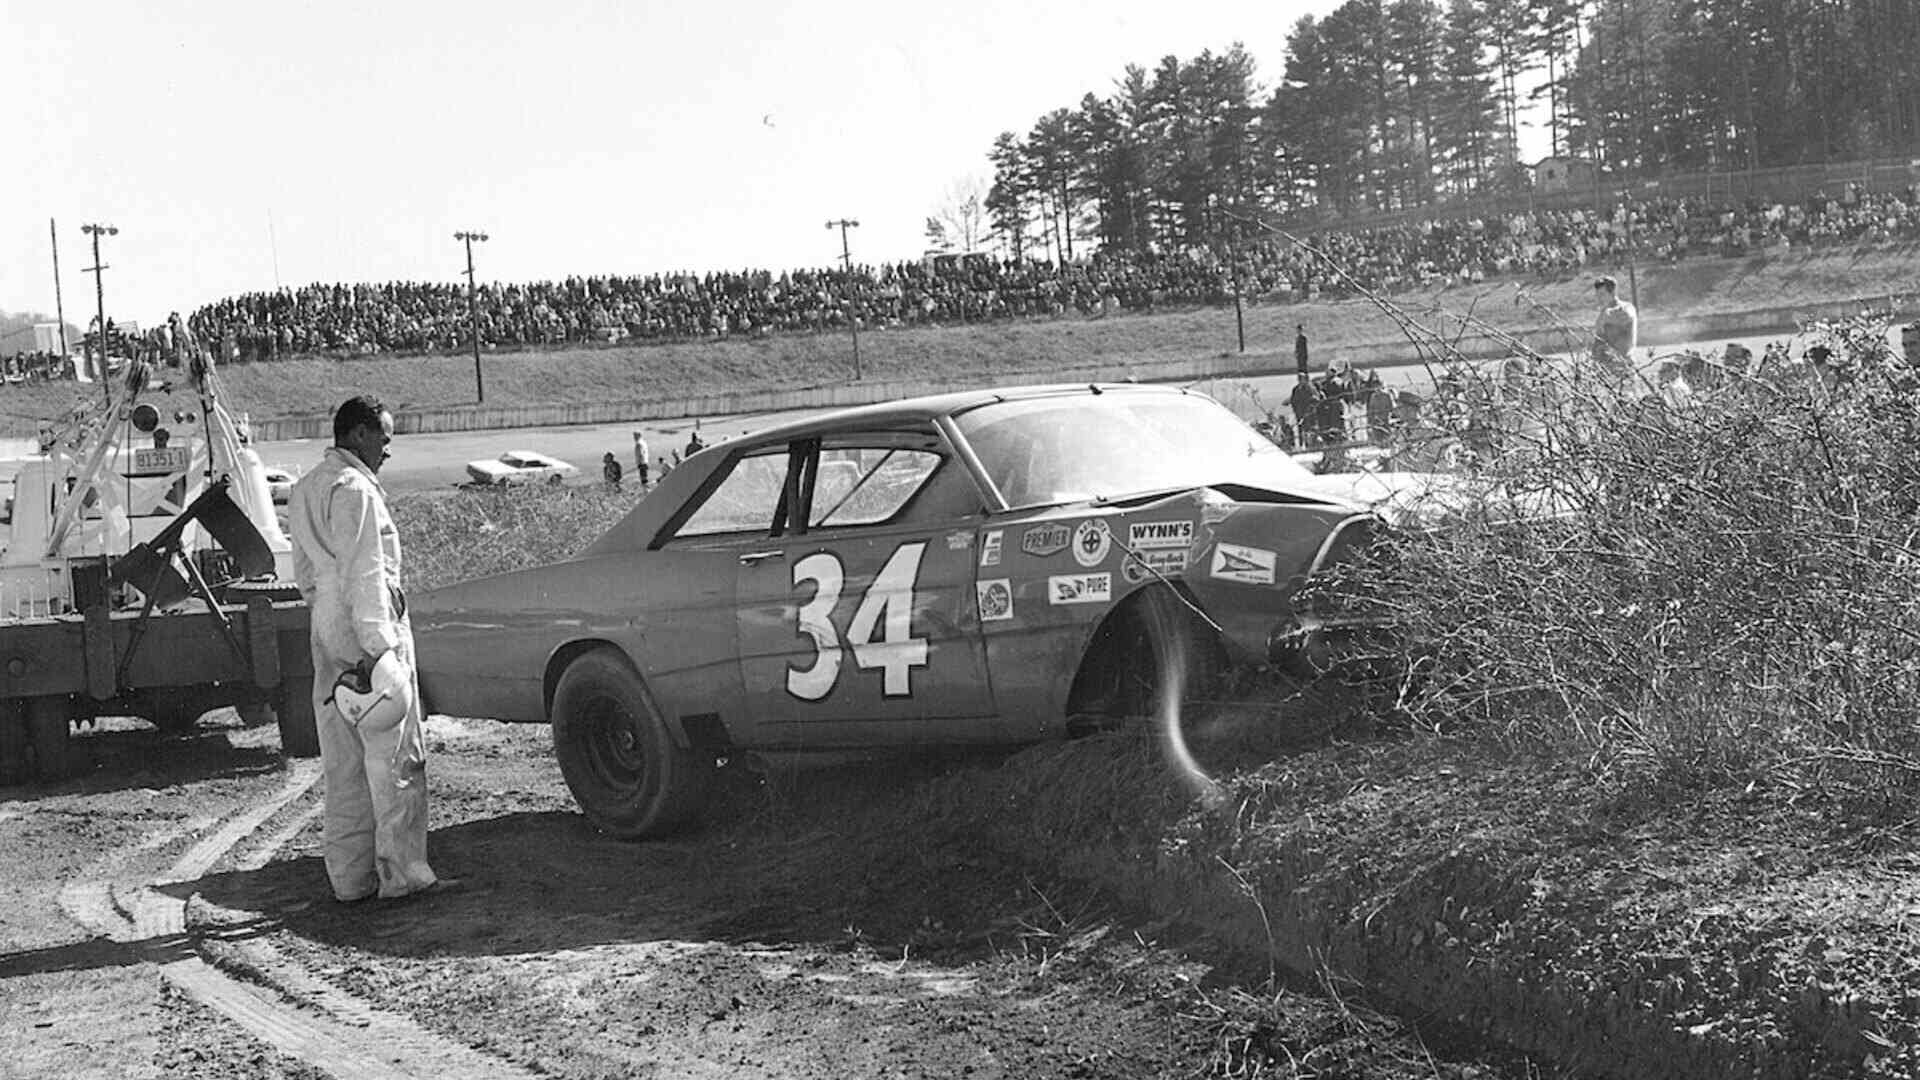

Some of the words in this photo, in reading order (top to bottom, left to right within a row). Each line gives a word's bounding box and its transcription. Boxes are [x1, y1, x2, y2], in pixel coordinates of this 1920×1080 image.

[1132, 523, 1191, 539] WYNN'S
[1086, 576, 1108, 593] PURE
[785, 541, 929, 702] 34
